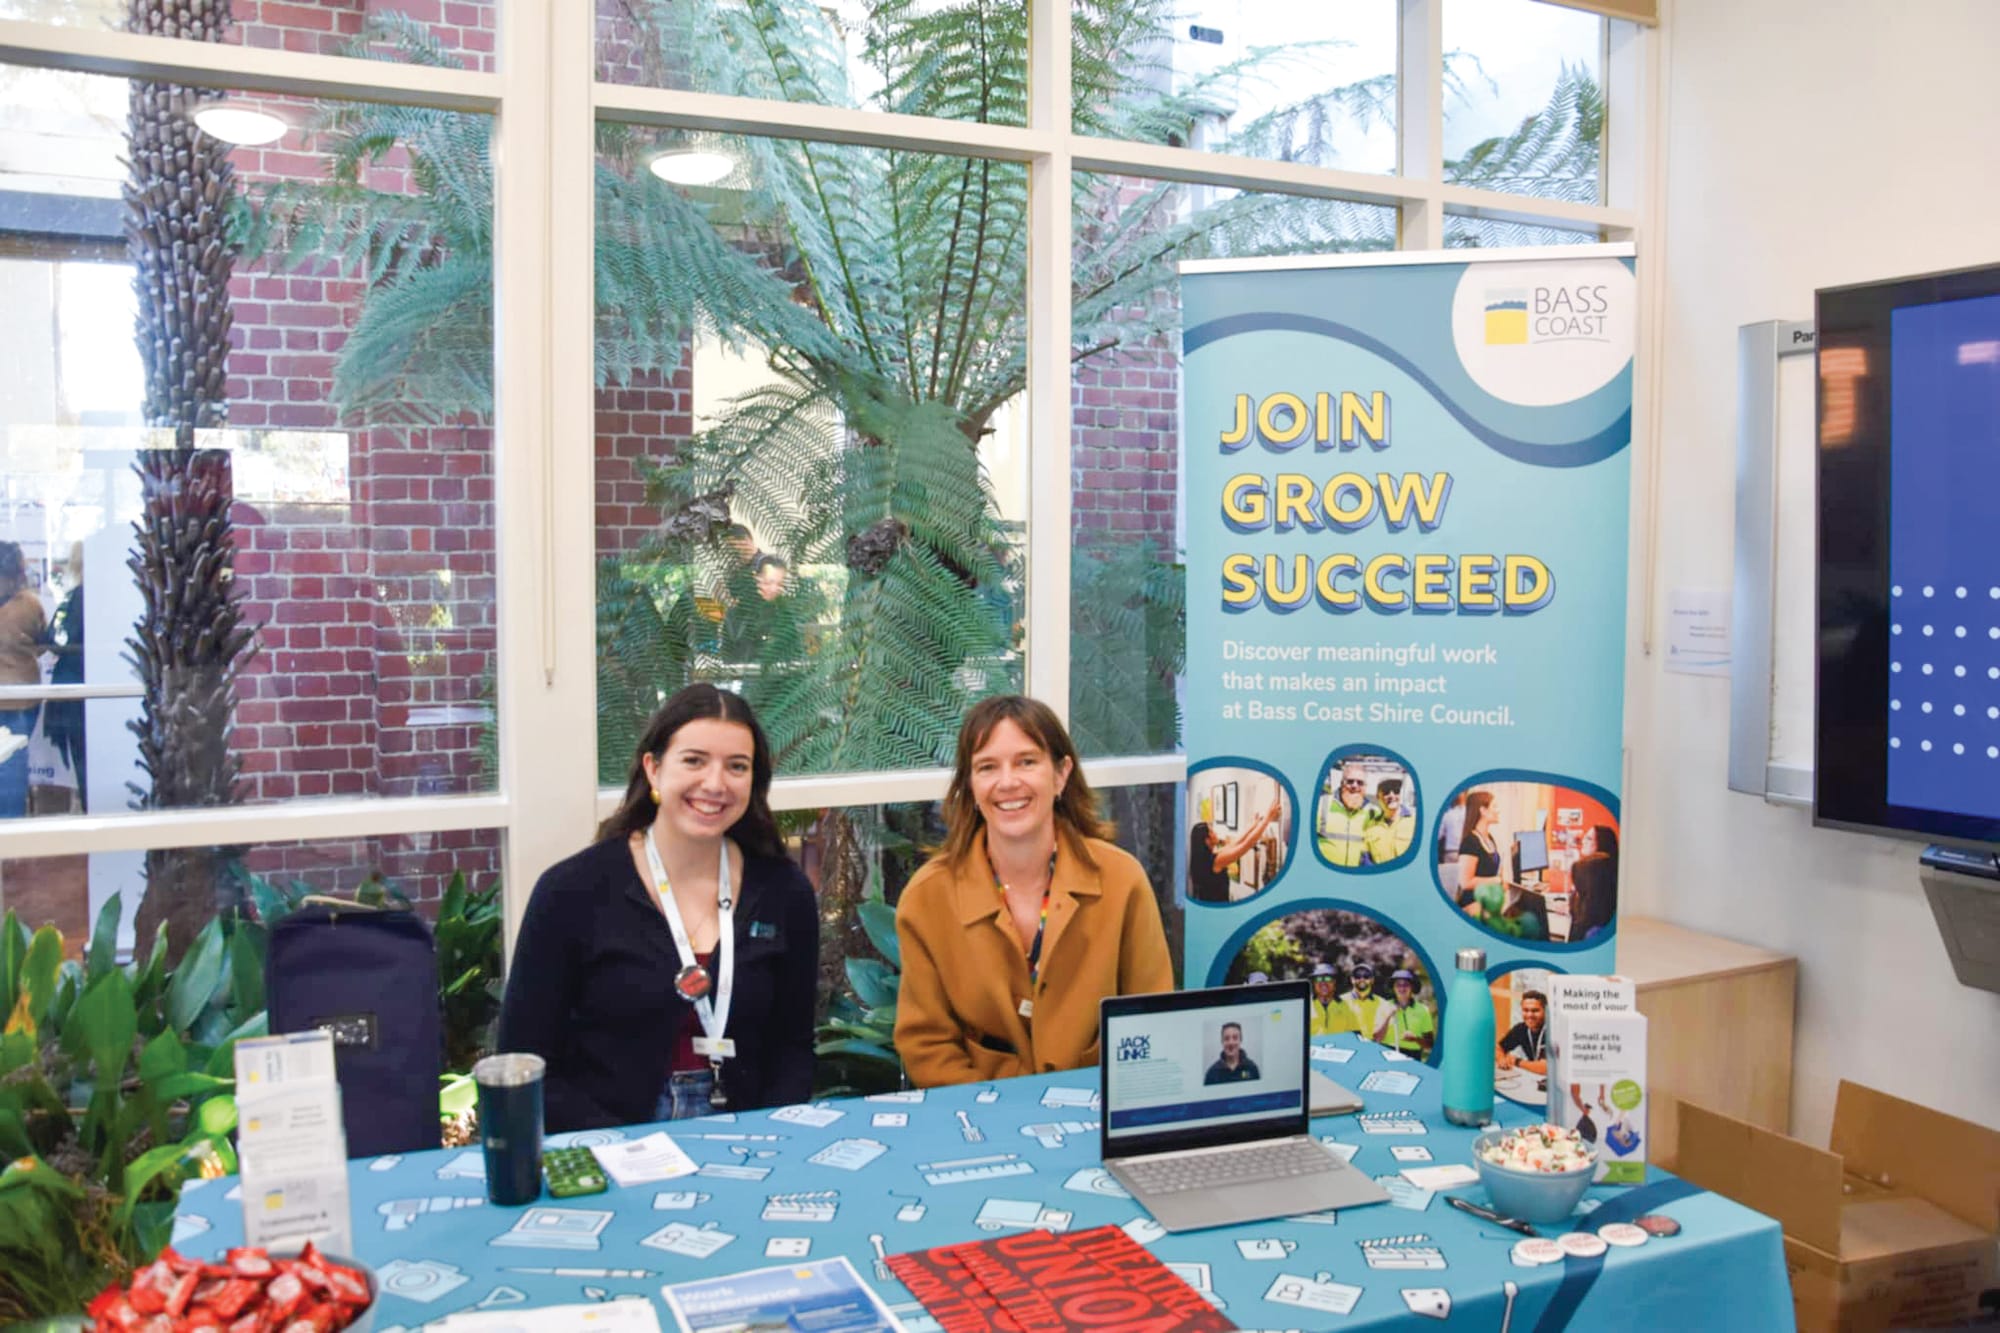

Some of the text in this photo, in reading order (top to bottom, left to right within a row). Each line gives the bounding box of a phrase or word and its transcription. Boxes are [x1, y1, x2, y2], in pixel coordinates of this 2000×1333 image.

[1535, 285, 1608, 314] BASS
[1535, 316, 1608, 336] COAST
[1219, 391, 1391, 451] JOIN
[1221, 472, 1454, 533] GROW
[1221, 554, 1556, 614] SUCCEED
[1222, 640, 1498, 666] Discover meaningful work
[1222, 671, 1447, 696] that makes an impact
[1222, 700, 1516, 726] at Bass Coast Shire Council.
[1562, 1002, 1589, 1011] most
[1591, 1002, 1602, 1011] of
[1563, 988, 1620, 1000] Making the
[1117, 1034, 1151, 1049] JACK
[1572, 1043, 1597, 1051] make
[1607, 1043, 1622, 1054] big
[1573, 1033, 1620, 1042] Small acts
[1117, 1047, 1150, 1061] LINKE
[1060, 1224, 1215, 1320] THEATRE
